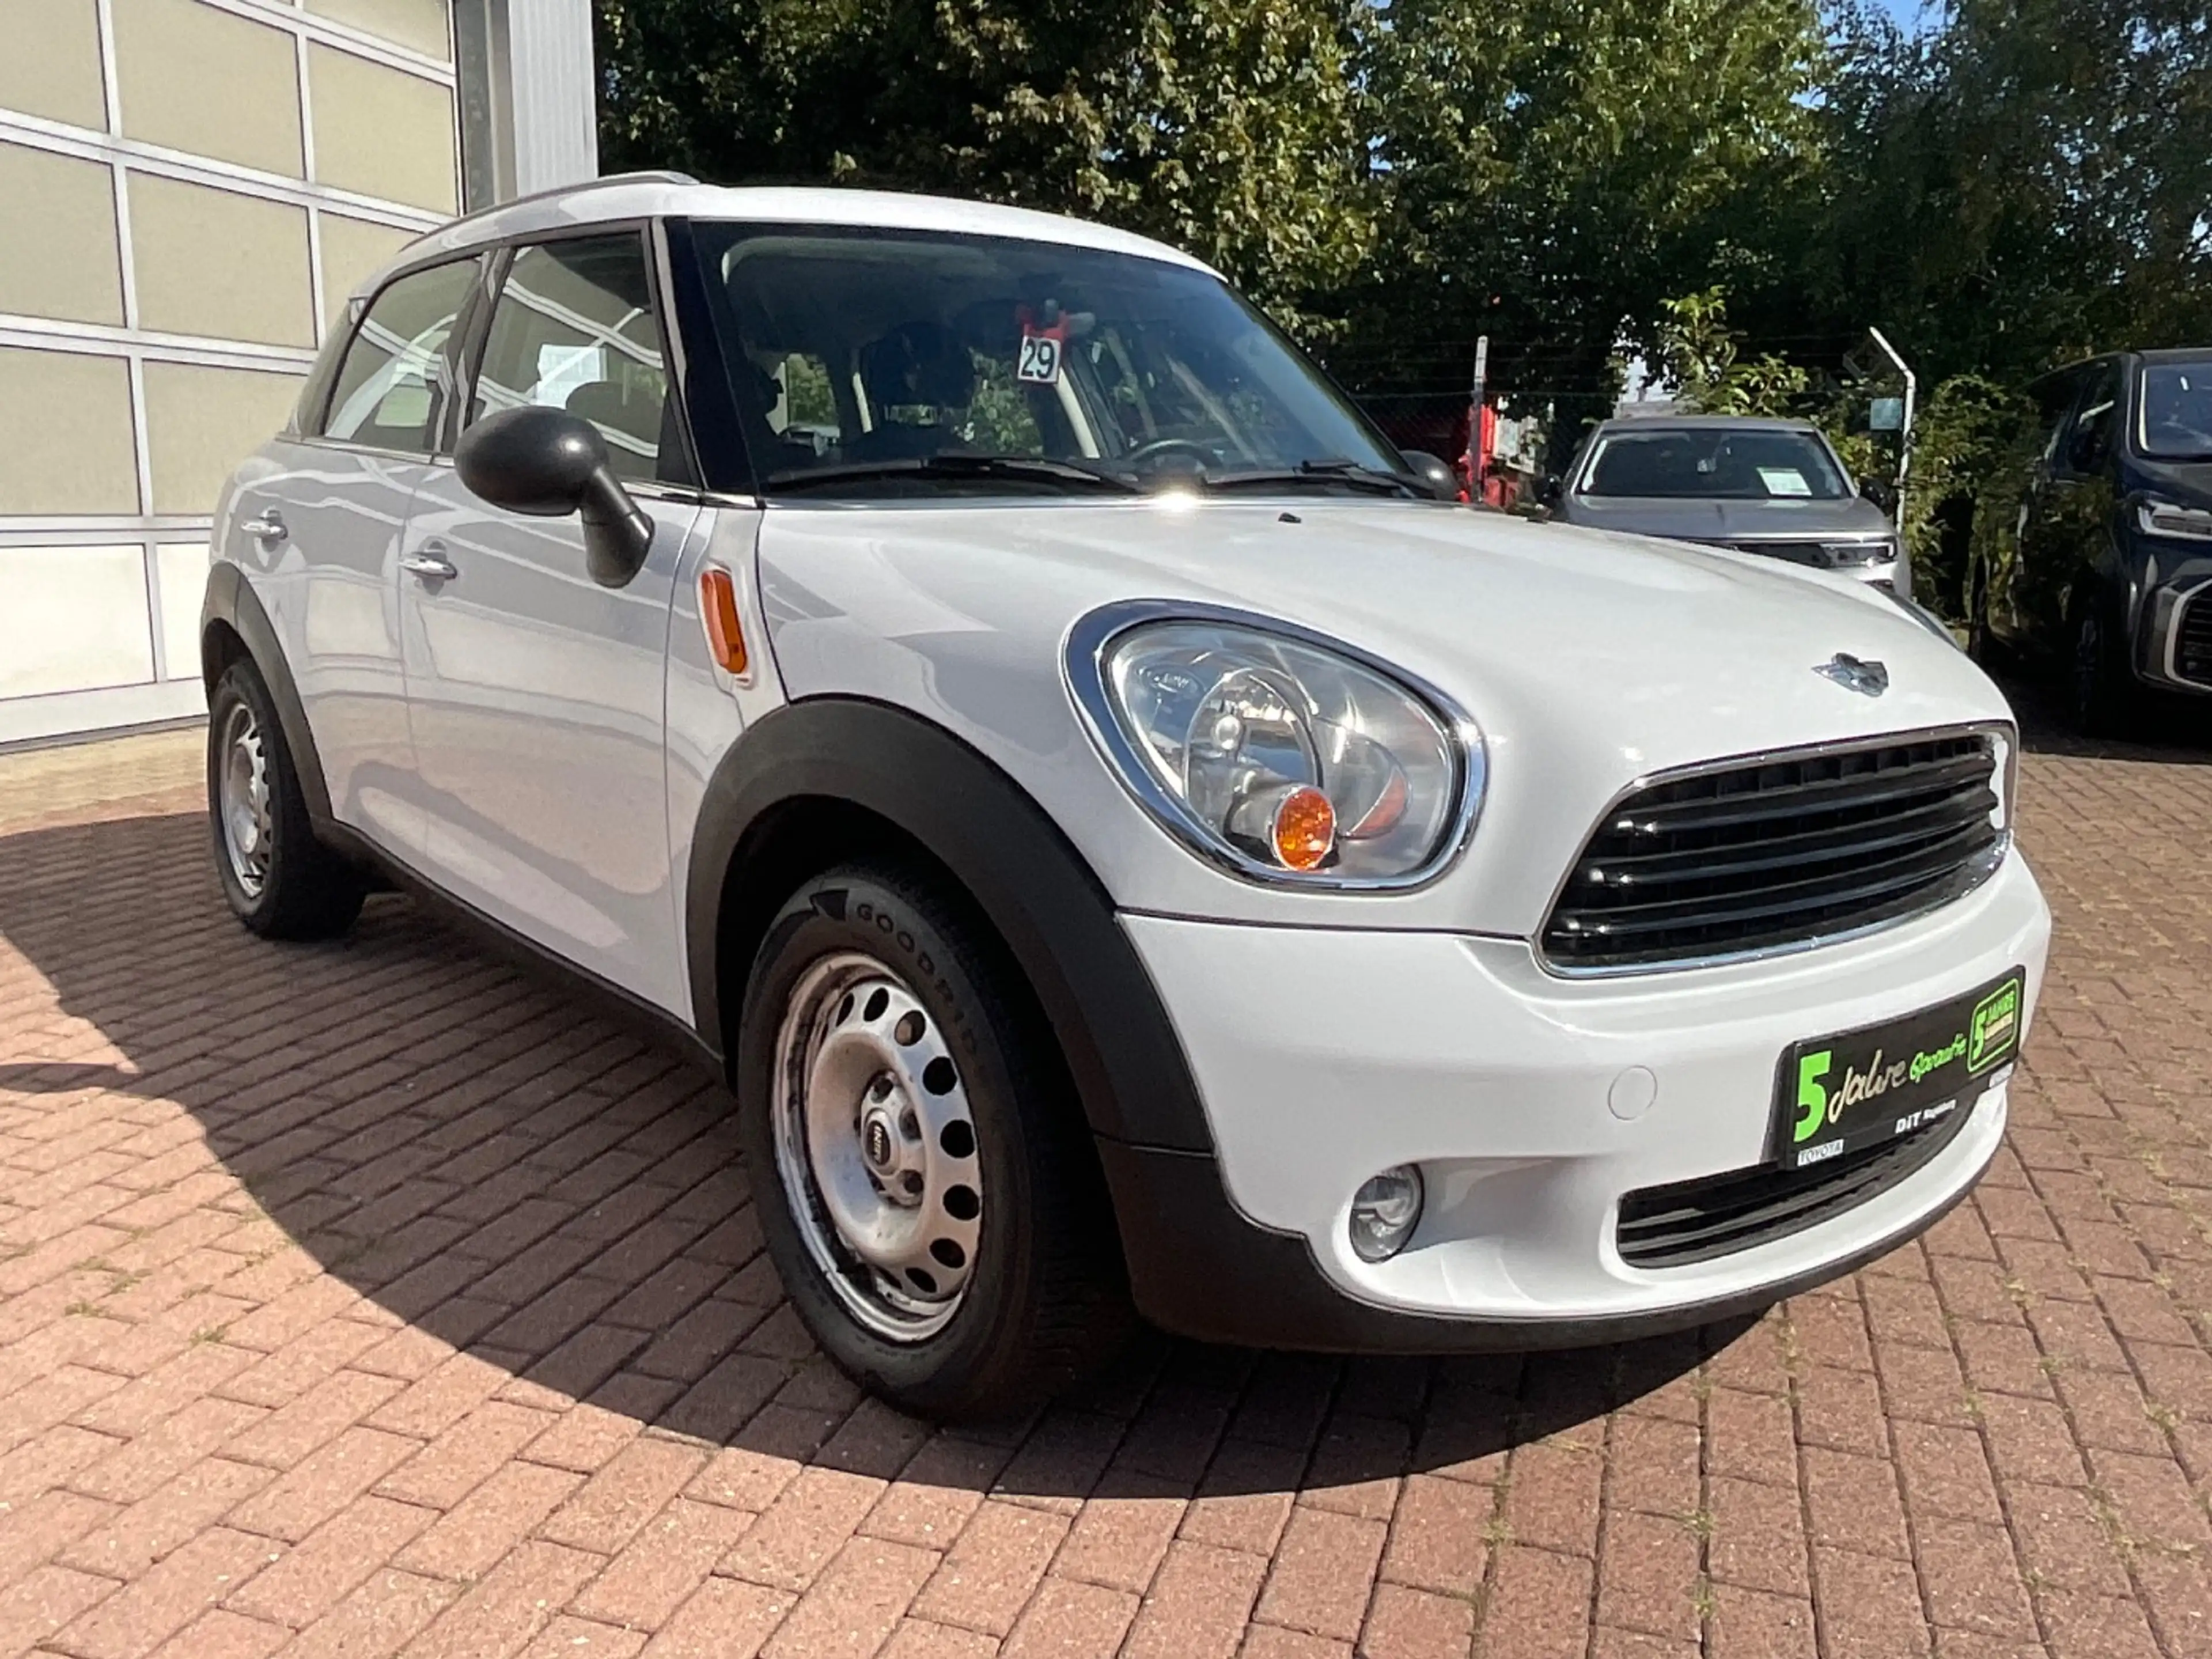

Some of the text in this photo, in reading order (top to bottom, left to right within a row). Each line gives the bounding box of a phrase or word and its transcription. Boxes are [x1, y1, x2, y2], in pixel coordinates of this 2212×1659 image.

[1021, 338, 1055, 379] 29
[1972, 1009, 1987, 1061] 5
[1794, 1050, 1832, 1143] 5
[1828, 1049, 1907, 1123] Jahre
[1895, 1110, 1922, 1134] DIT
[1798, 1140, 1843, 1165] TOYOTA
